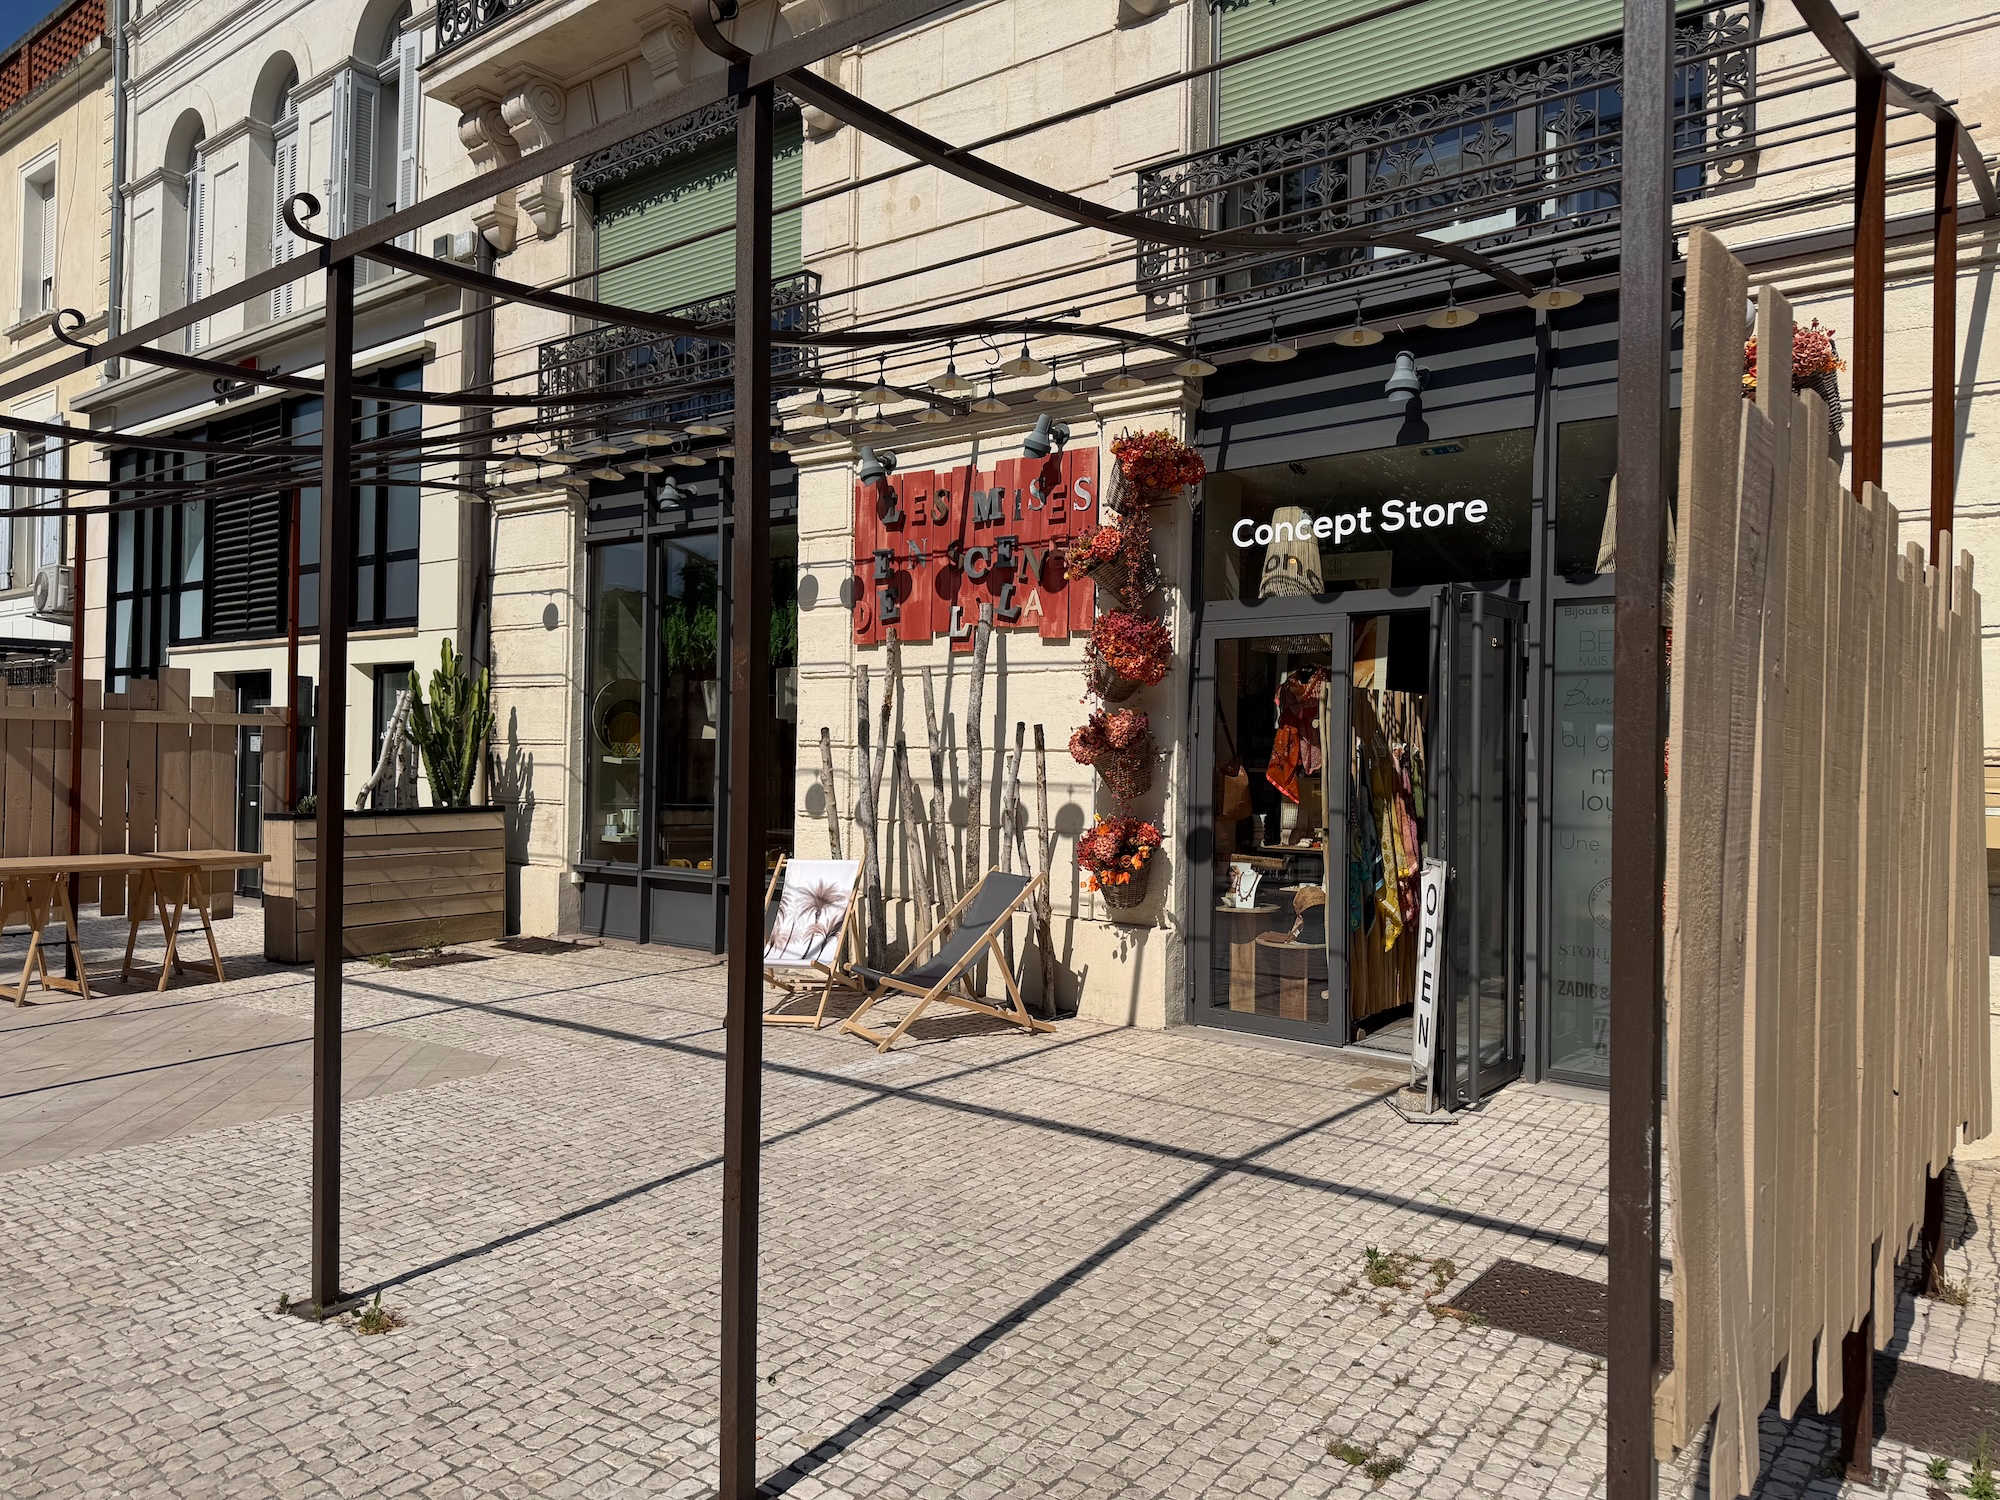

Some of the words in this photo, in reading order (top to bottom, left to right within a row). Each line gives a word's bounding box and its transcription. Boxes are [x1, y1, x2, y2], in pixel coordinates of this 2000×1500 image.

[881, 487, 951, 524] LES
[971, 476, 1092, 524] MISES
[1231, 506, 1373, 548] Concept
[1379, 498, 1489, 533] Store
[872, 537, 928, 580] EN
[854, 588, 900, 632] DE
[949, 582, 1044, 638] LLA
[1564, 606, 1599, 620] Bijoux
[1561, 726, 1586, 757] by
[1559, 831, 1600, 852] Une
[1418, 883, 1438, 1050] OPEN
[1556, 979, 1599, 1000] ZADIG
